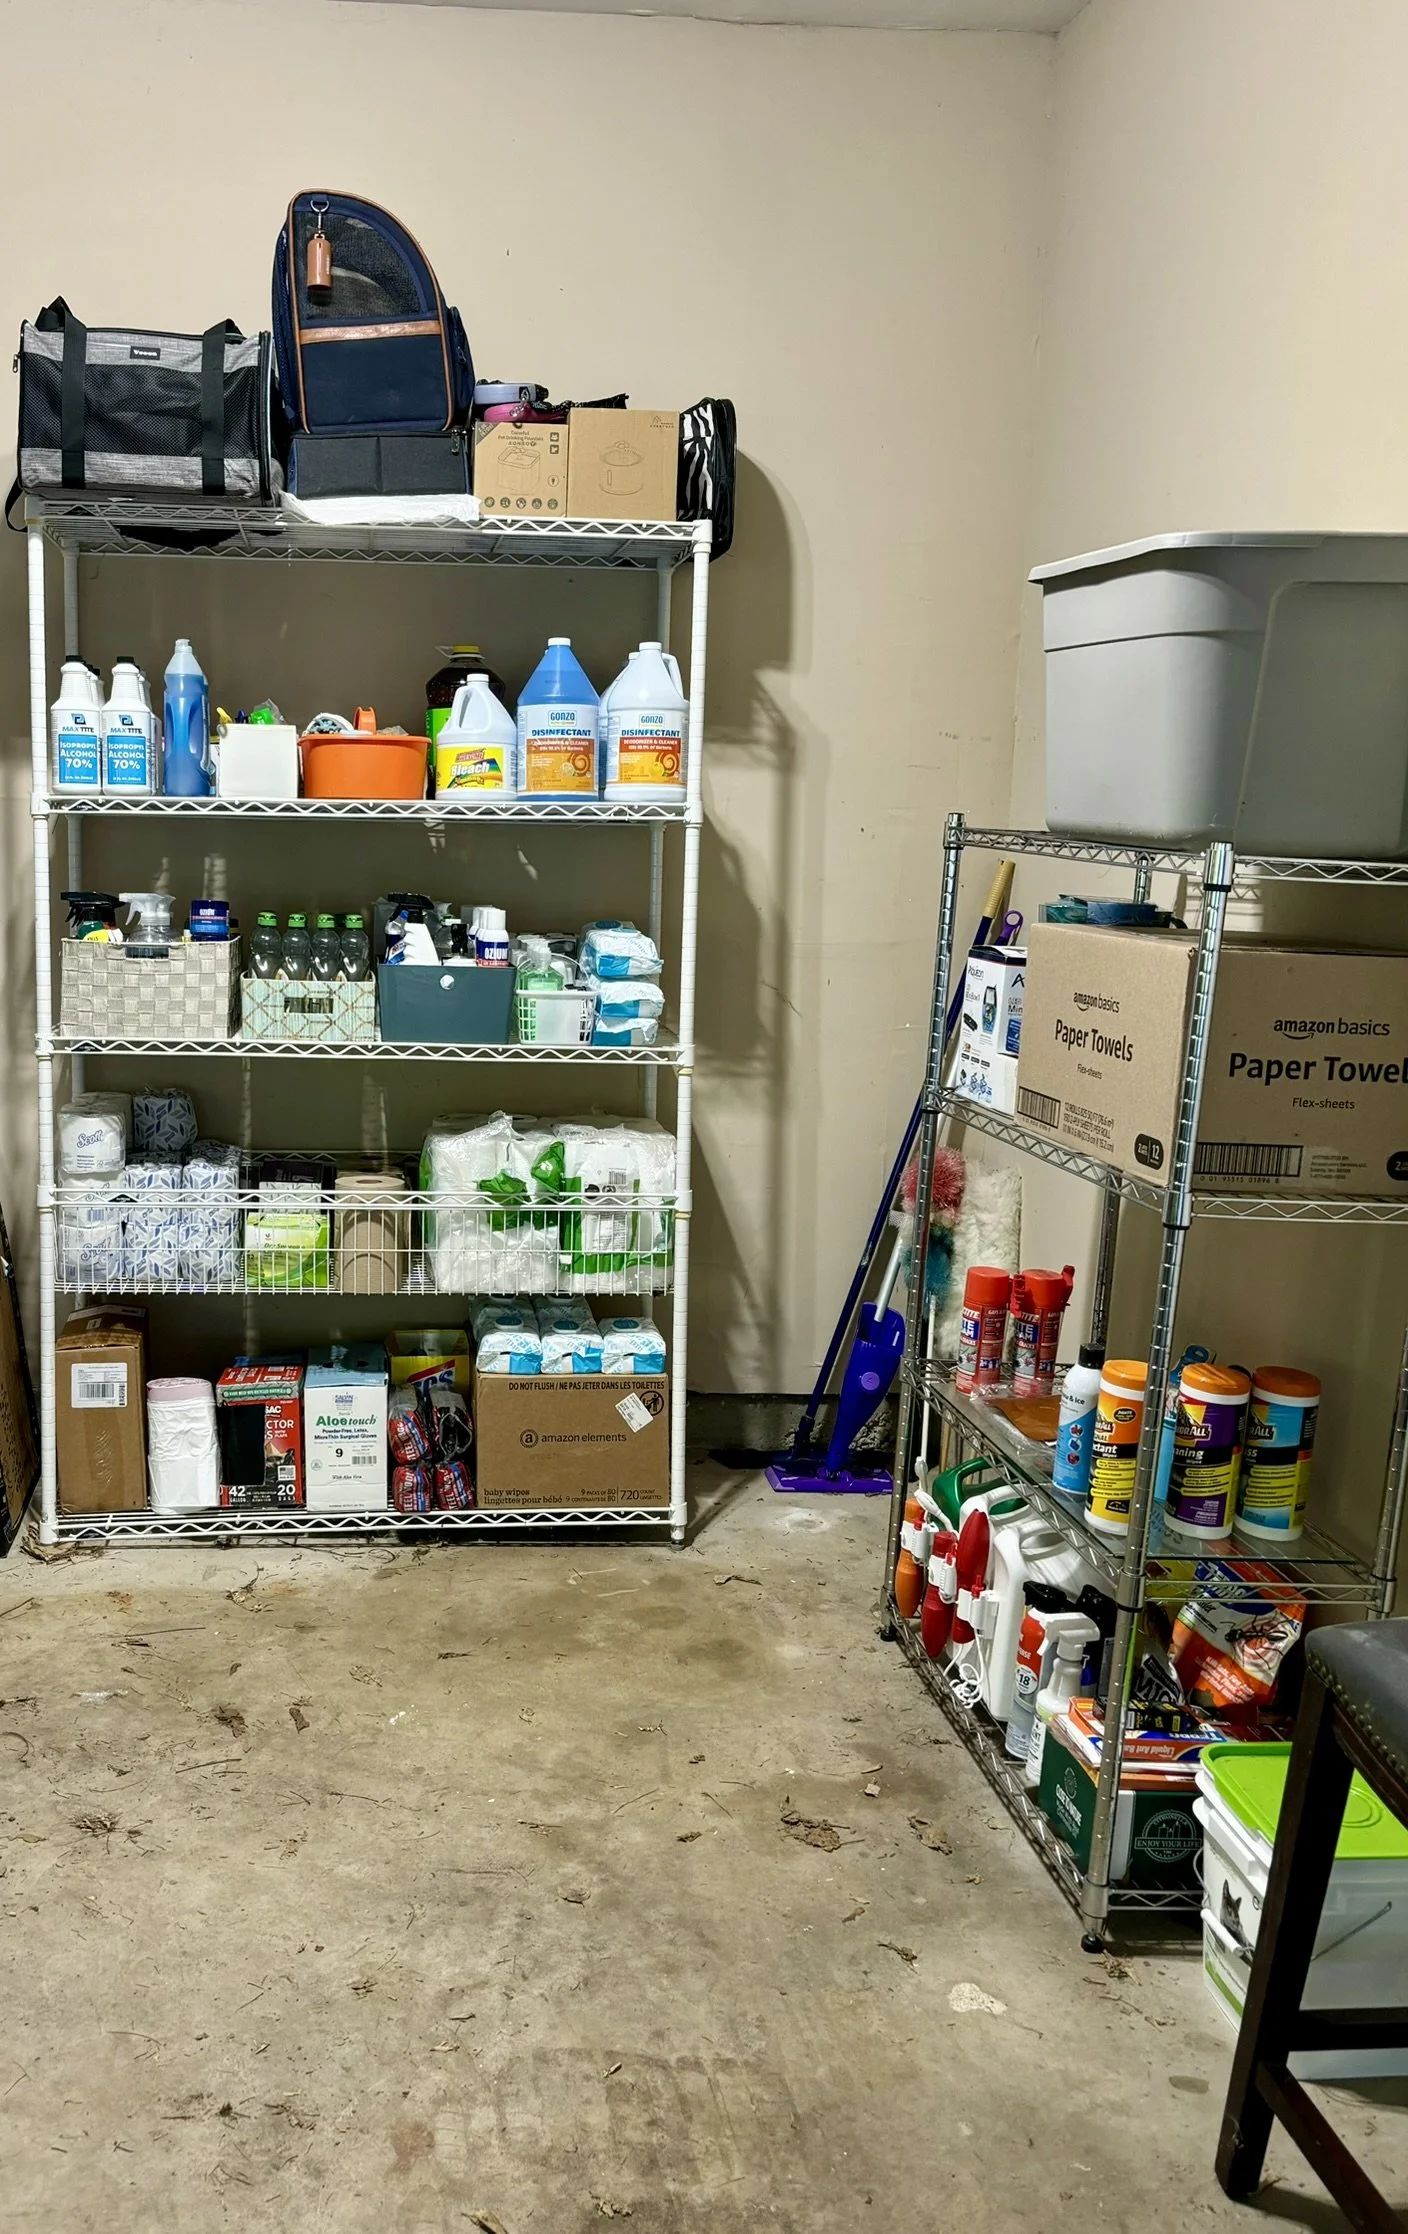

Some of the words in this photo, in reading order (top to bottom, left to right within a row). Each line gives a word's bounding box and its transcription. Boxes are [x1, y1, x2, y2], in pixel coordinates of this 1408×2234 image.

[550, 712, 575, 720] GONZO
[641, 715, 664, 724] GONZO
[531, 728, 592, 737] DISINFECTANT
[621, 728, 681, 737] DISINFECTANT
[65, 758, 93, 769] 70%
[112, 759, 141, 770] 70%
[451, 761, 490, 776] Bleach
[1073, 992, 1098, 1009] amazon
[1097, 992, 1120, 1014] basics
[1273, 1019, 1335, 1035] amazon
[1337, 1017, 1390, 1036] basics
[1055, 1018, 1089, 1051] Paper
[1091, 1028, 1134, 1062] Towels
[1229, 1052, 1317, 1086] Paper
[1292, 1097, 1355, 1110] Flex-sheets
[77, 1129, 104, 1149] Scott
[1151, 1144, 1160, 1160] 12
[509, 1382, 519, 1391] DO
[520, 1382, 534, 1390] NOT
[534, 1382, 555, 1390] FLUSH
[559, 1382, 568, 1390] NE
[568, 1381, 582, 1390] PAS
[582, 1382, 601, 1391] JETER
[601, 1382, 619, 1390] DANS
[619, 1381, 631, 1390] LES
[632, 1381, 665, 1390] TOILETTES
[541, 1433, 580, 1443] amazon
[581, 1432, 628, 1443] elements
[335, 1447, 344, 1458] 9
[229, 1485, 246, 1497] 42
[277, 1484, 296, 1496] 20
[484, 1487, 504, 1496] baby
[505, 1487, 530, 1497] wipes
[620, 1489, 639, 1500] 720
[484, 1496, 521, 1505] lingettes
[521, 1497, 541, 1505] pour
[1019, 1673, 1031, 1687] 18
[1136, 1744, 1150, 1754] Ant
[1150, 1744, 1176, 1758] Liquid
[1161, 1840, 1182, 1848] YOUR
